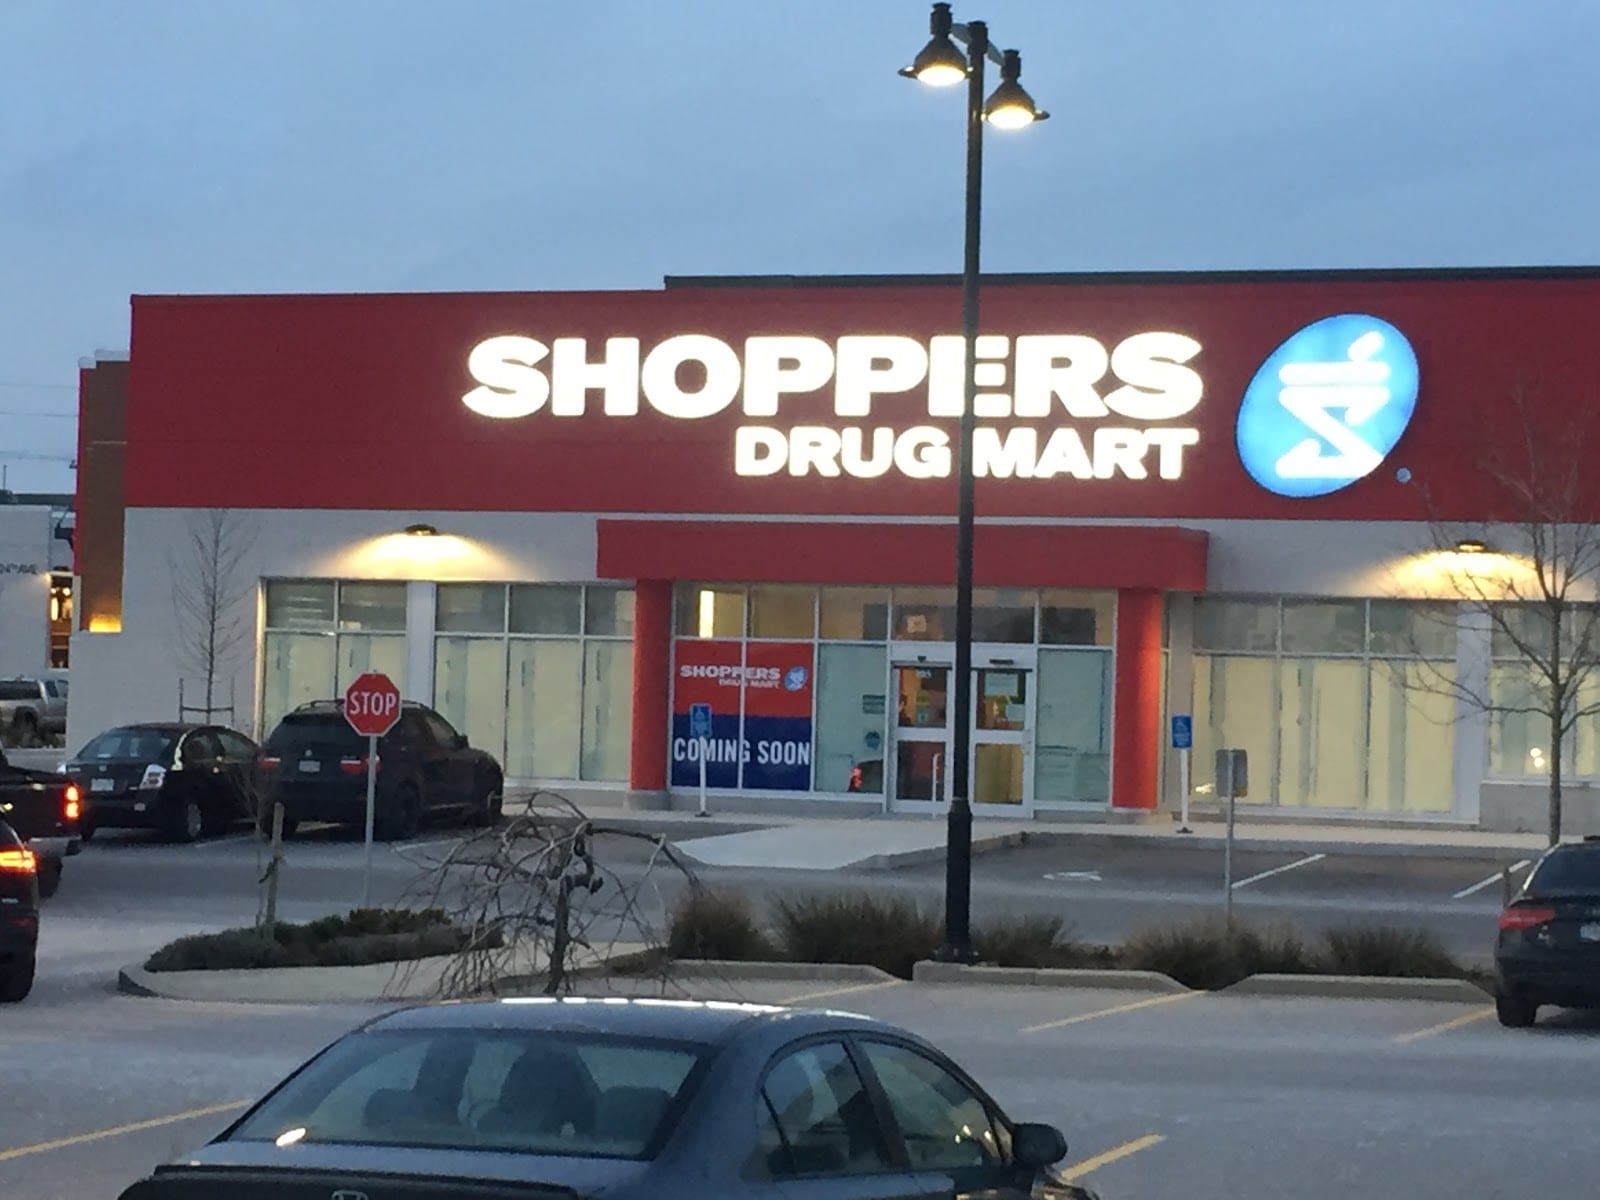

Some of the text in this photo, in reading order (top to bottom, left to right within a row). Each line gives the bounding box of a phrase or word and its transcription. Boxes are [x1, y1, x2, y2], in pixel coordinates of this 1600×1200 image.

[462, 332, 1204, 419] SHOPPERS
[735, 425, 1200, 480] DRUG MART
[680, 664, 781, 680] SHOPPERS
[349, 691, 397, 716] STOP
[673, 737, 811, 766] COMING SOON
